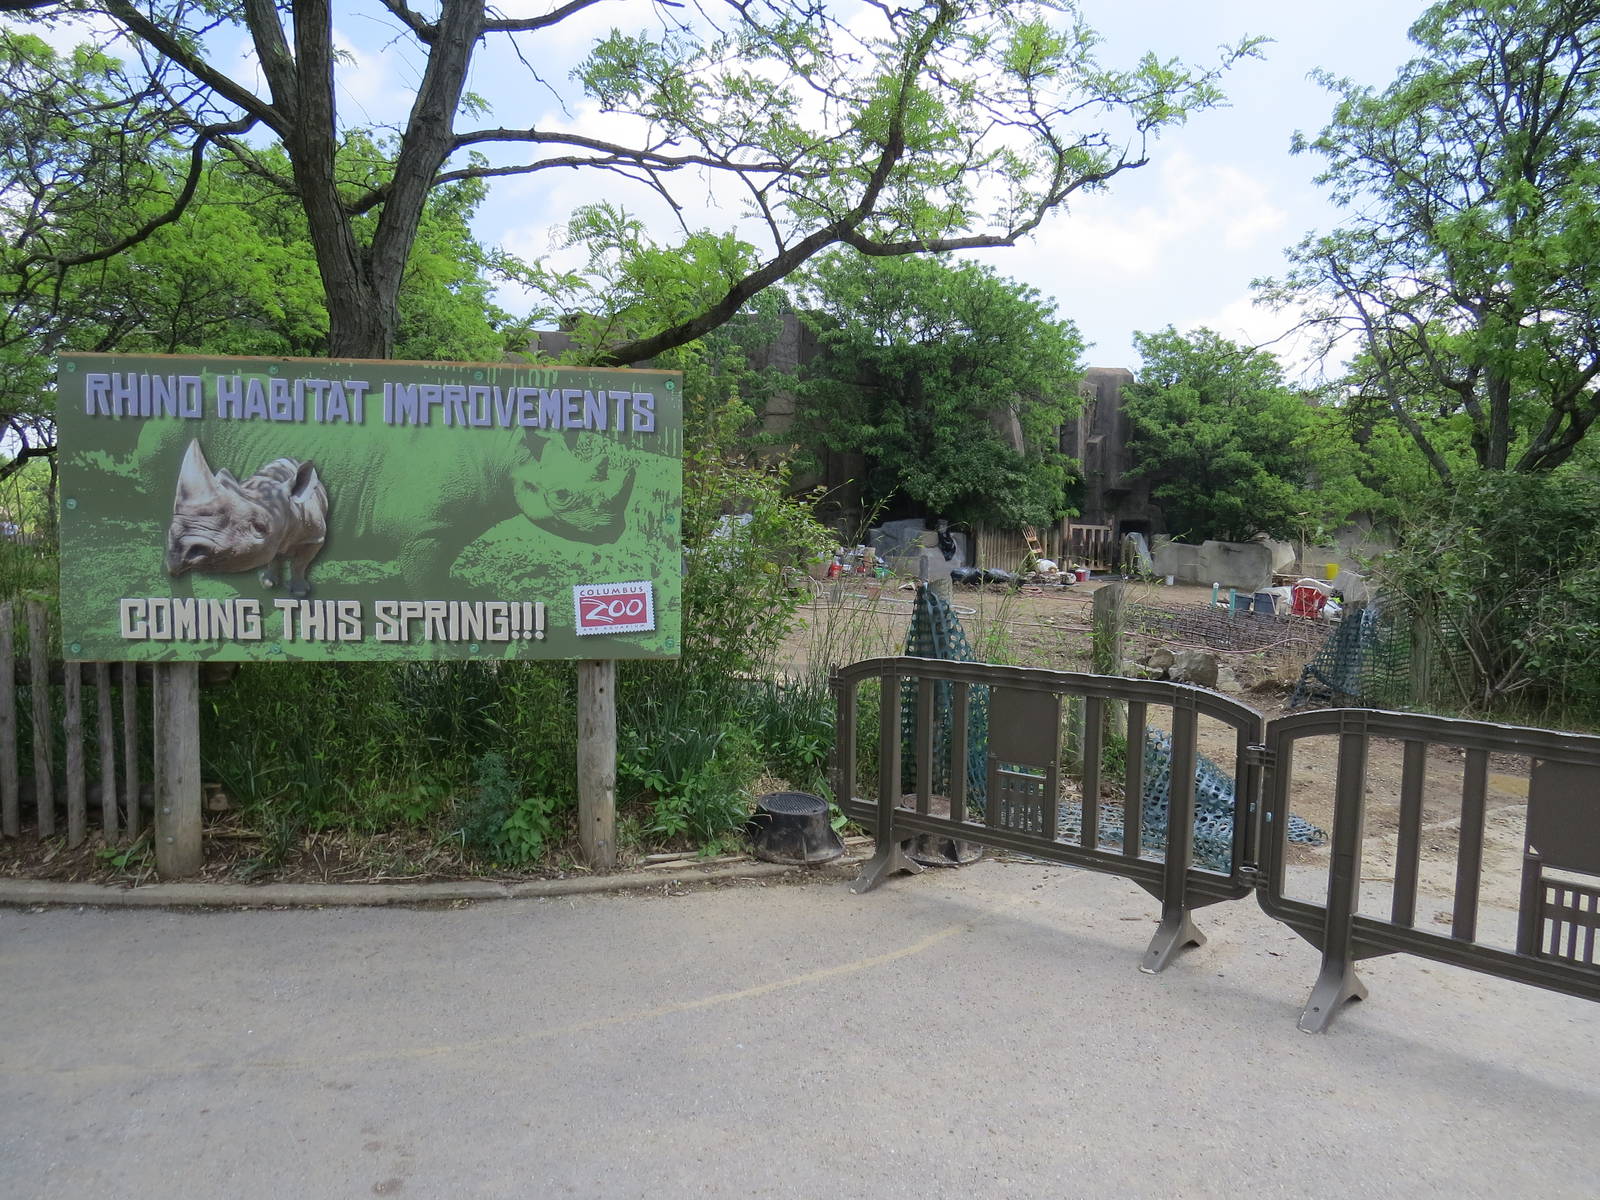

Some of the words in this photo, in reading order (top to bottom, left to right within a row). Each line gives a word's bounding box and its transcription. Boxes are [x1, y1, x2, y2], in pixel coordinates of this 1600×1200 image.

[86, 372, 203, 419] RHINO
[217, 375, 369, 425] HABITAT
[383, 382, 655, 433] IMPROVEMENTS
[580, 586, 643, 596] COLUMBUS
[120, 598, 262, 641] COMING
[274, 598, 362, 641] THIS
[375, 600, 545, 642] SPRING!!!
[581, 599, 643, 623] ZOO
